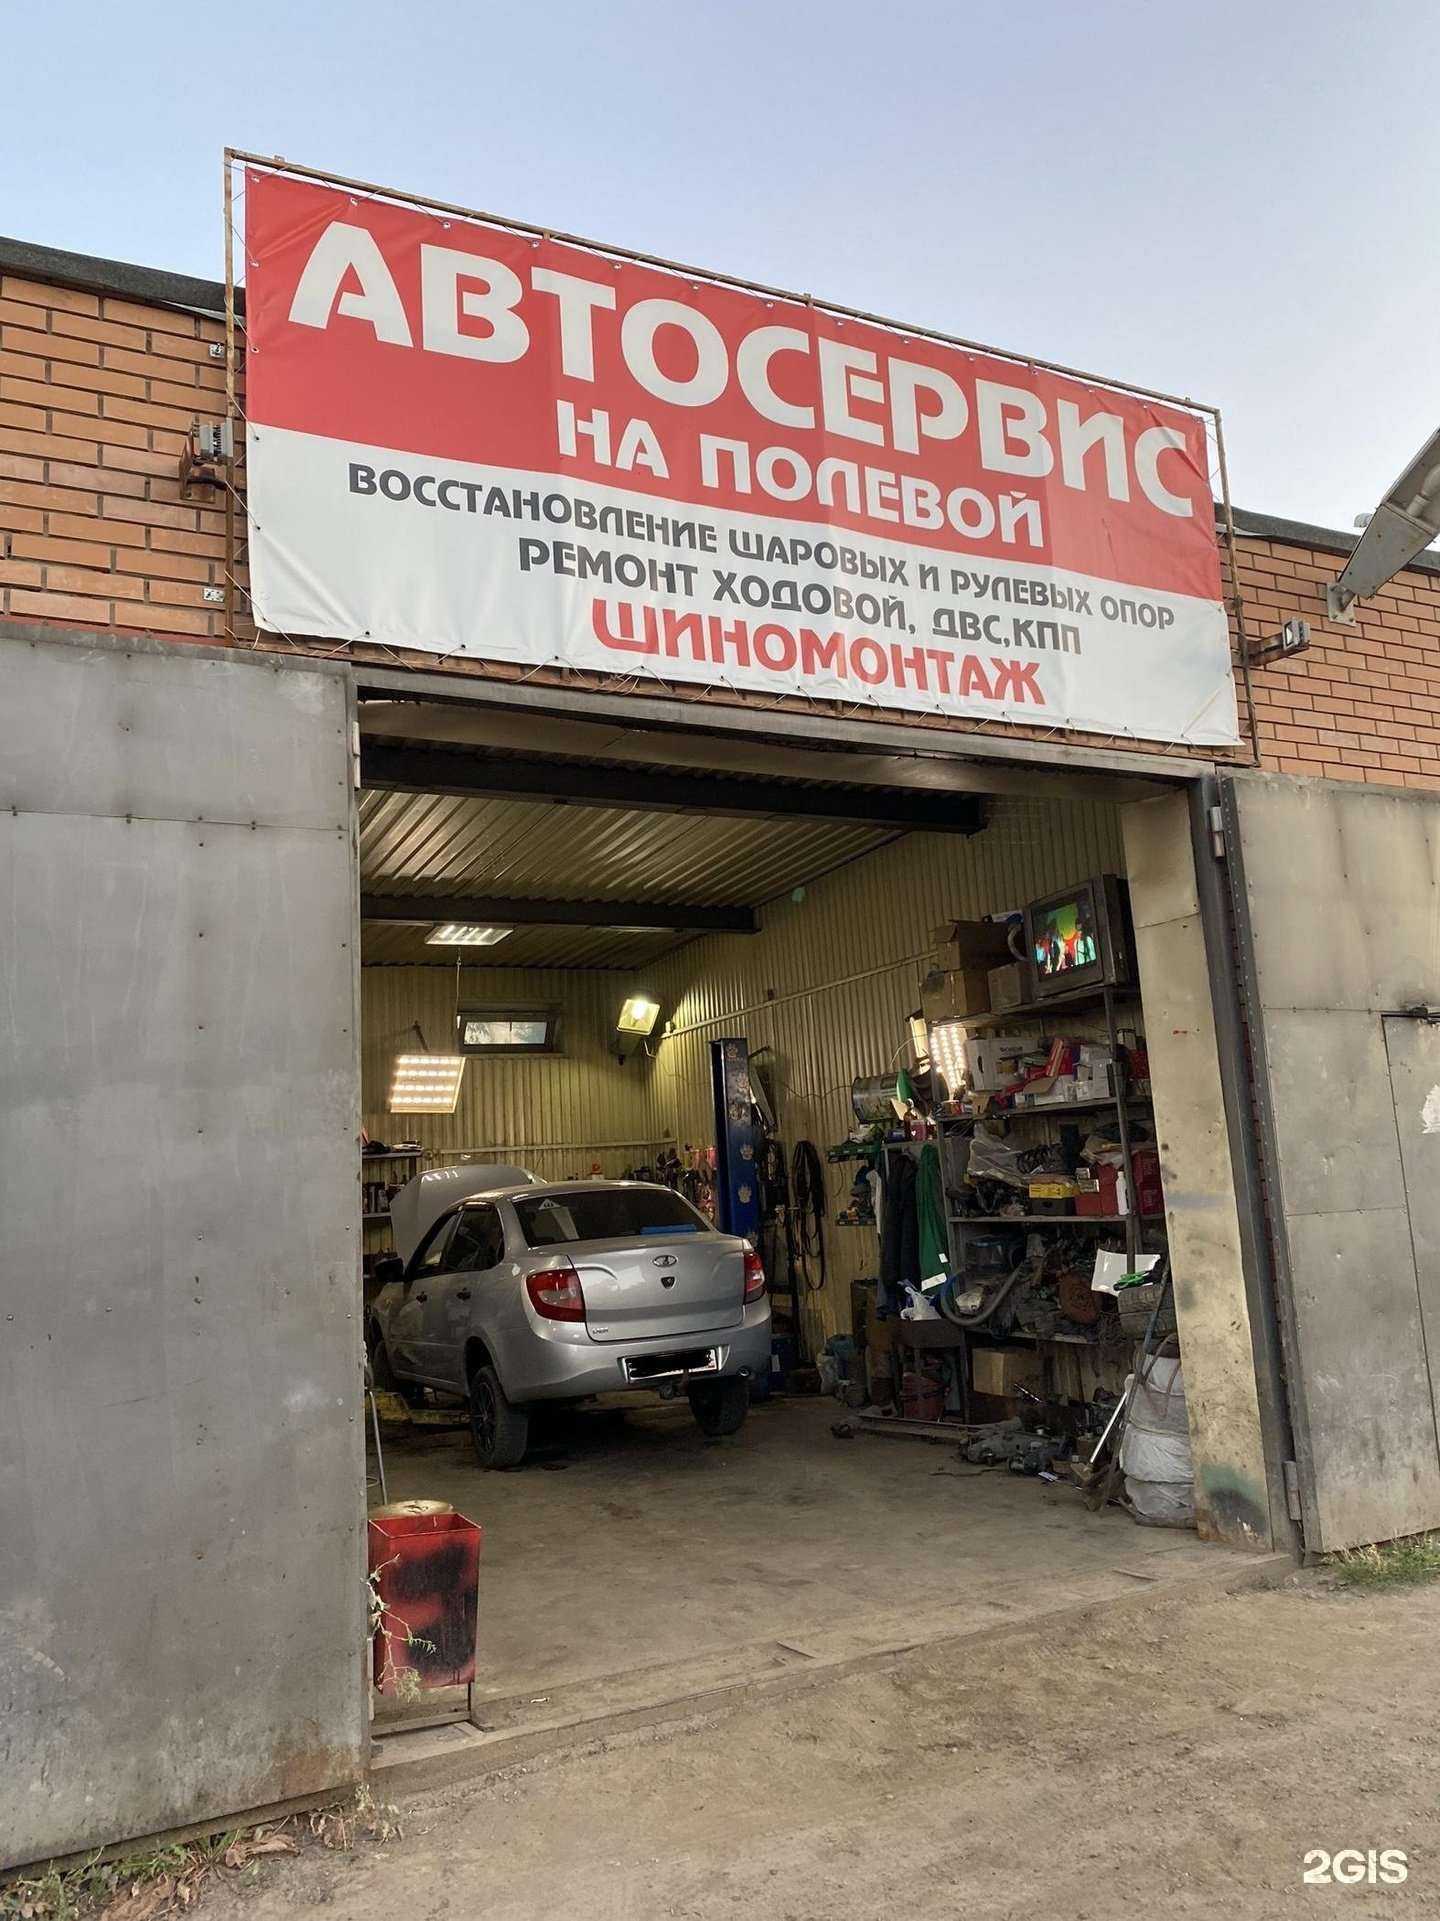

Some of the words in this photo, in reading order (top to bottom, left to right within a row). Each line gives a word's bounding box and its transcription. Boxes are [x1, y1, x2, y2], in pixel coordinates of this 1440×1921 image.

[288, 220, 1193, 518] АВТОСЕРВИС
[348, 462, 718, 554] ВОССТАНОВЛЕНИЕ
[728, 528, 908, 587] ШАРОВЫХ
[918, 563, 941, 593] И
[950, 569, 1094, 617] РУЛЕВЫХ
[1099, 595, 1176, 631] ОПОР
[556, 399, 671, 480] НА
[699, 432, 1045, 549] ПОЛЕВОЙ
[518, 536, 699, 597] РЕМОНТ
[712, 569, 916, 635] ХОДОВОЙ,
[592, 598, 1047, 706] ШИНОМОНТАЖ
